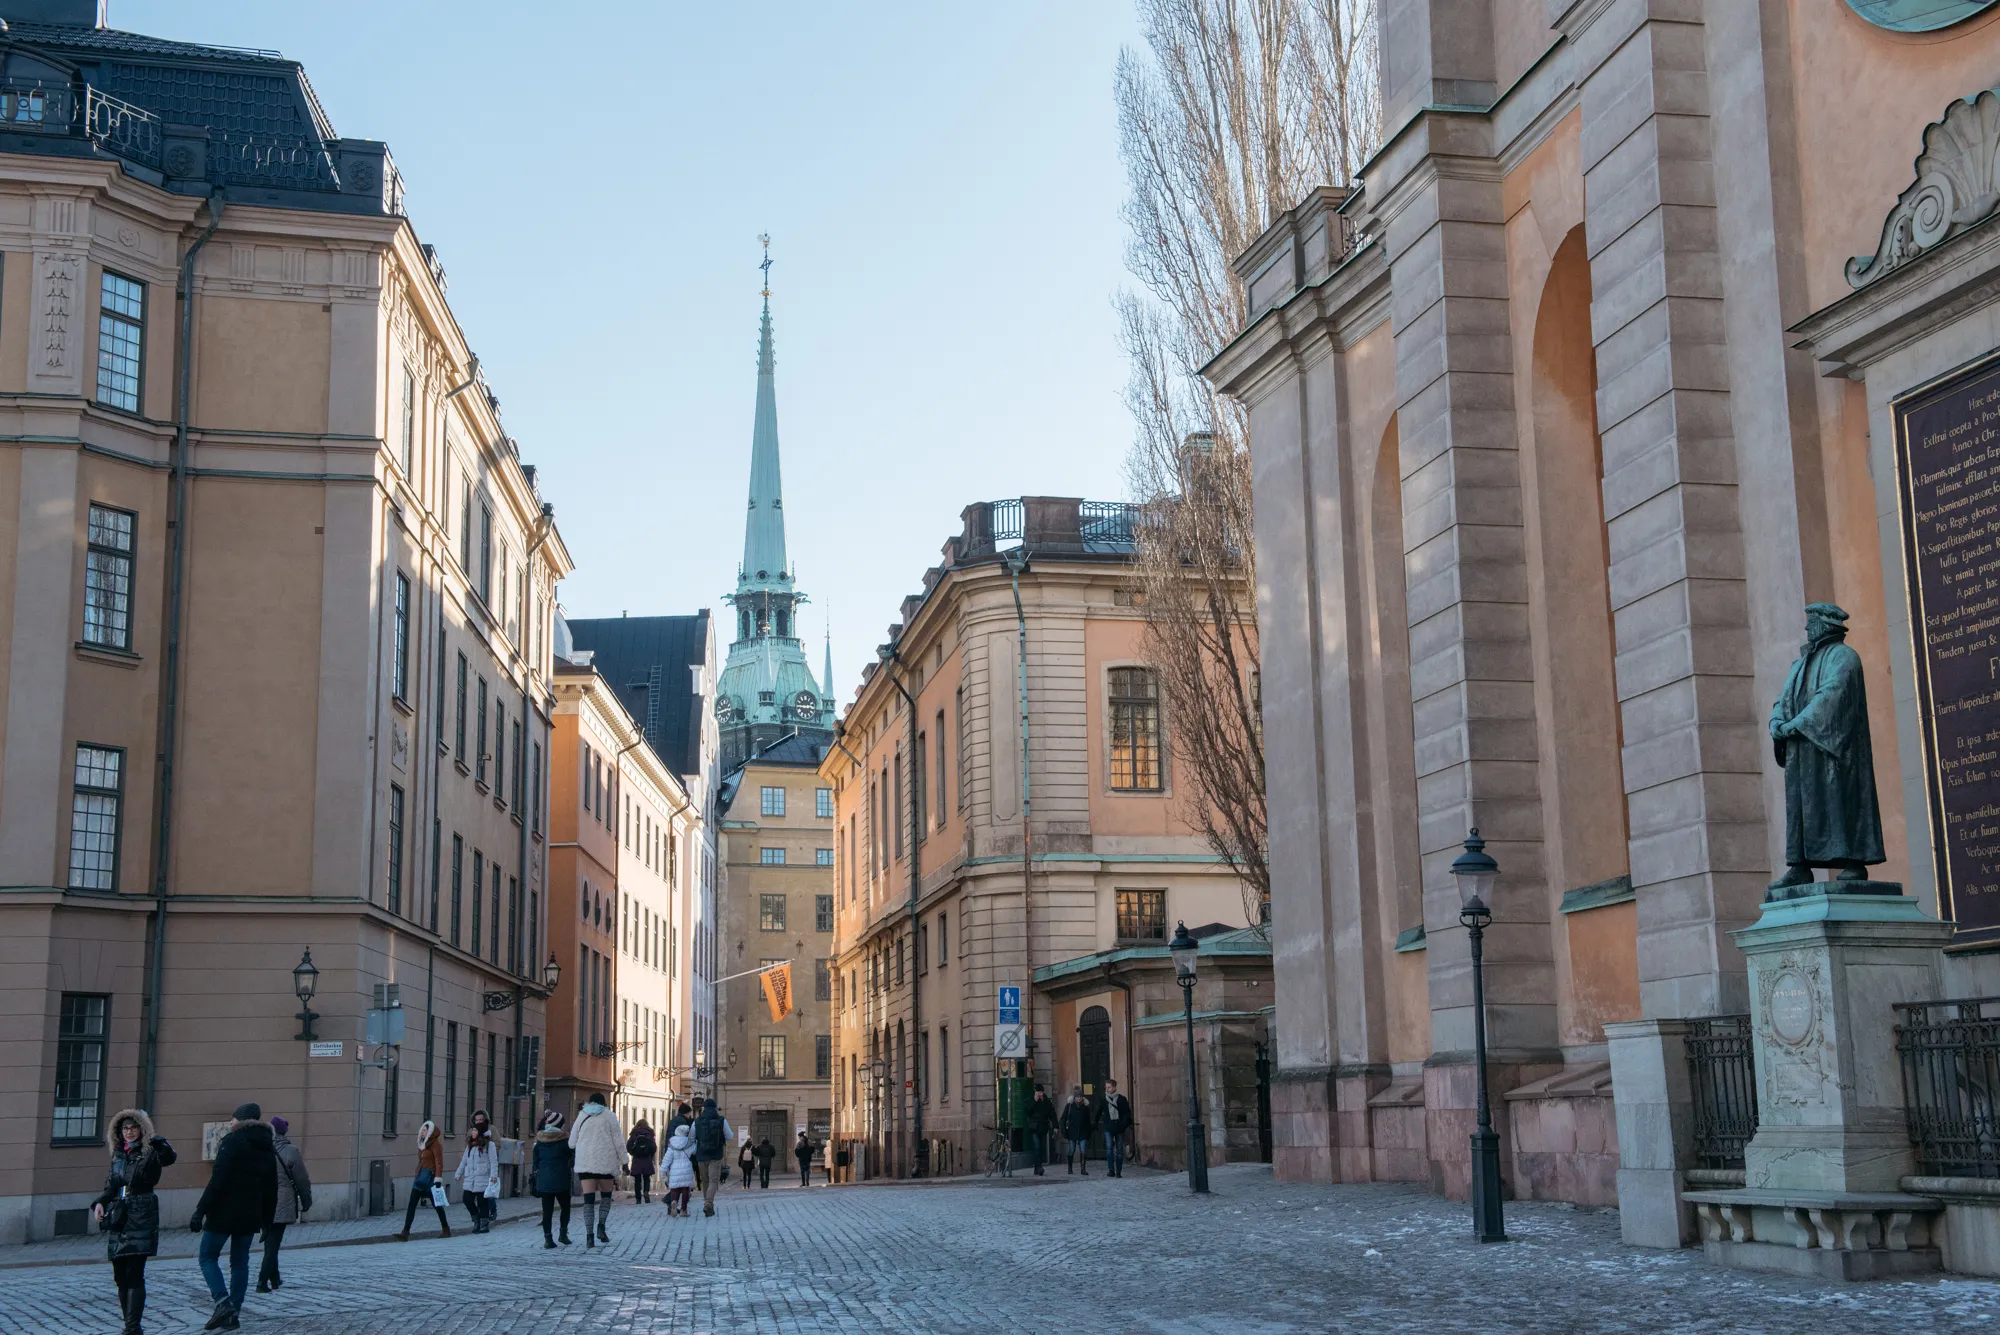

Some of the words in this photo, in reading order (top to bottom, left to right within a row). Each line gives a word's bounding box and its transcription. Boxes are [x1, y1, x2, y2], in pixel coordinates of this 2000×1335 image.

[1952, 440, 1972, 454] Anno
[1913, 478, 1919, 488] A
[1963, 455, 1985, 468] urbem
[1936, 481, 1962, 497] Fulmine
[1965, 470, 1988, 485] afflata
[1950, 515, 1968, 528] Regis
[1921, 546, 1927, 558] A
[1942, 574, 1952, 585] Ne
[1956, 588, 1963, 599] A
[1964, 584, 1981, 599] parte
[1927, 615, 1940, 627] Sed
[1929, 632, 1953, 645] Chorus
[1955, 625, 1963, 638] ad
[1936, 646, 1964, 660] Tandem
[1989, 634, 1997, 645] &
[1936, 704, 1956, 716] Turris
[1957, 736, 1964, 748] Et
[1941, 758, 1959, 773] Opus
[1960, 829, 1968, 840] Et
